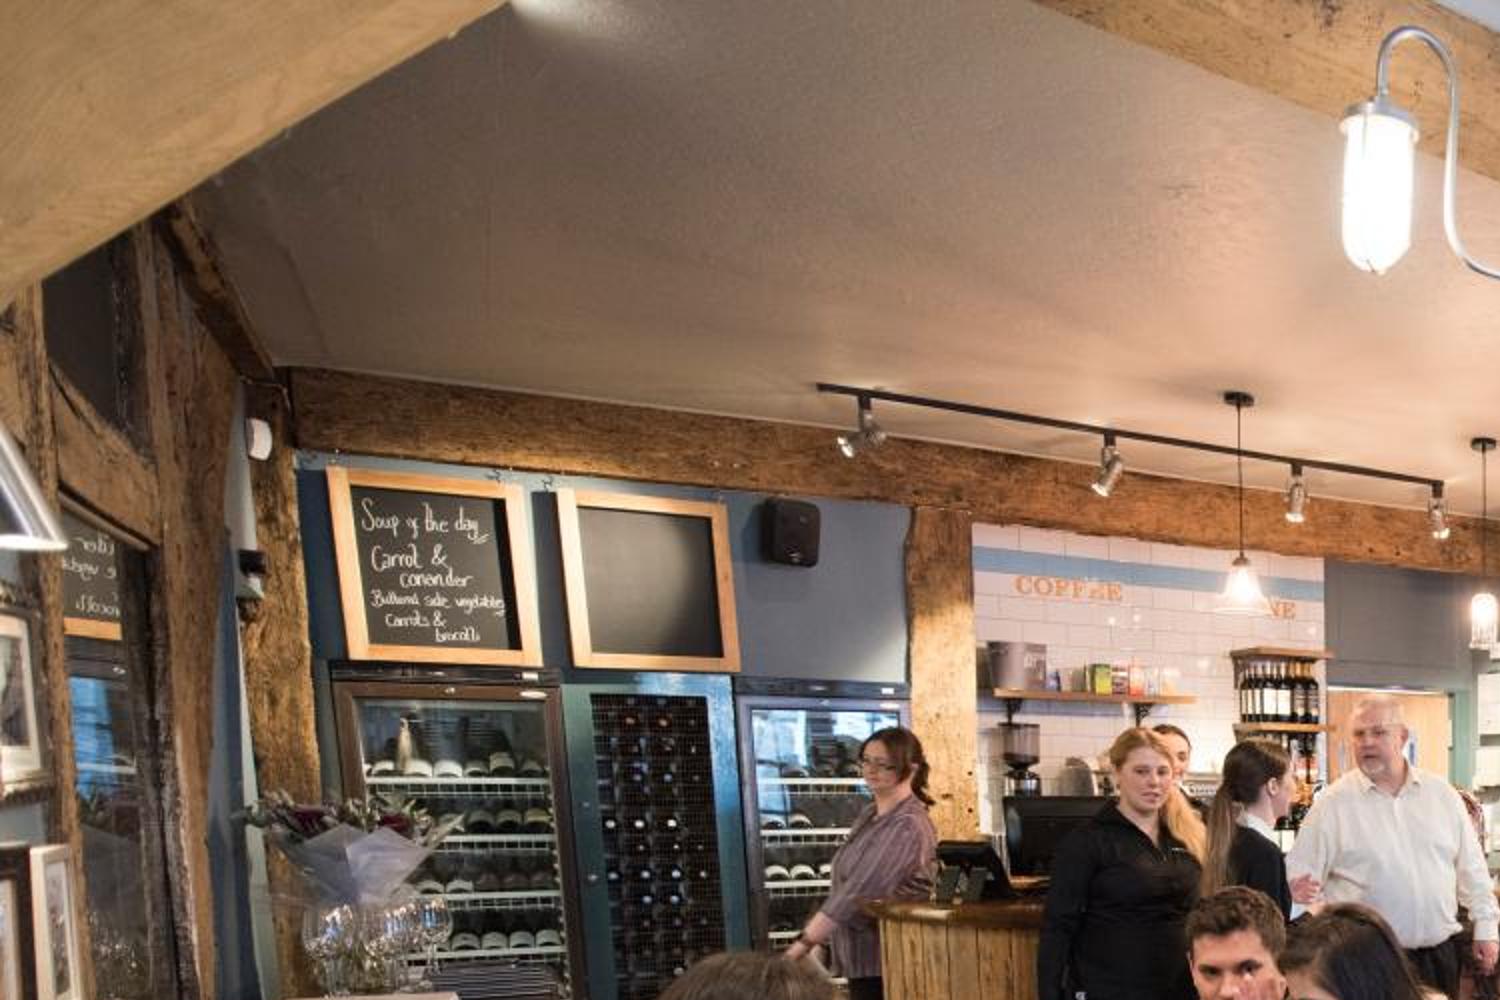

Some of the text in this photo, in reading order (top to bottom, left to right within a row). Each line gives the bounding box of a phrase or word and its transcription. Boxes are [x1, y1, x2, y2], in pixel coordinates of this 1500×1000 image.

[360, 498, 478, 541] Soup of the day
[371, 543, 448, 571] Carrot &
[433, 610, 447, 627] &
